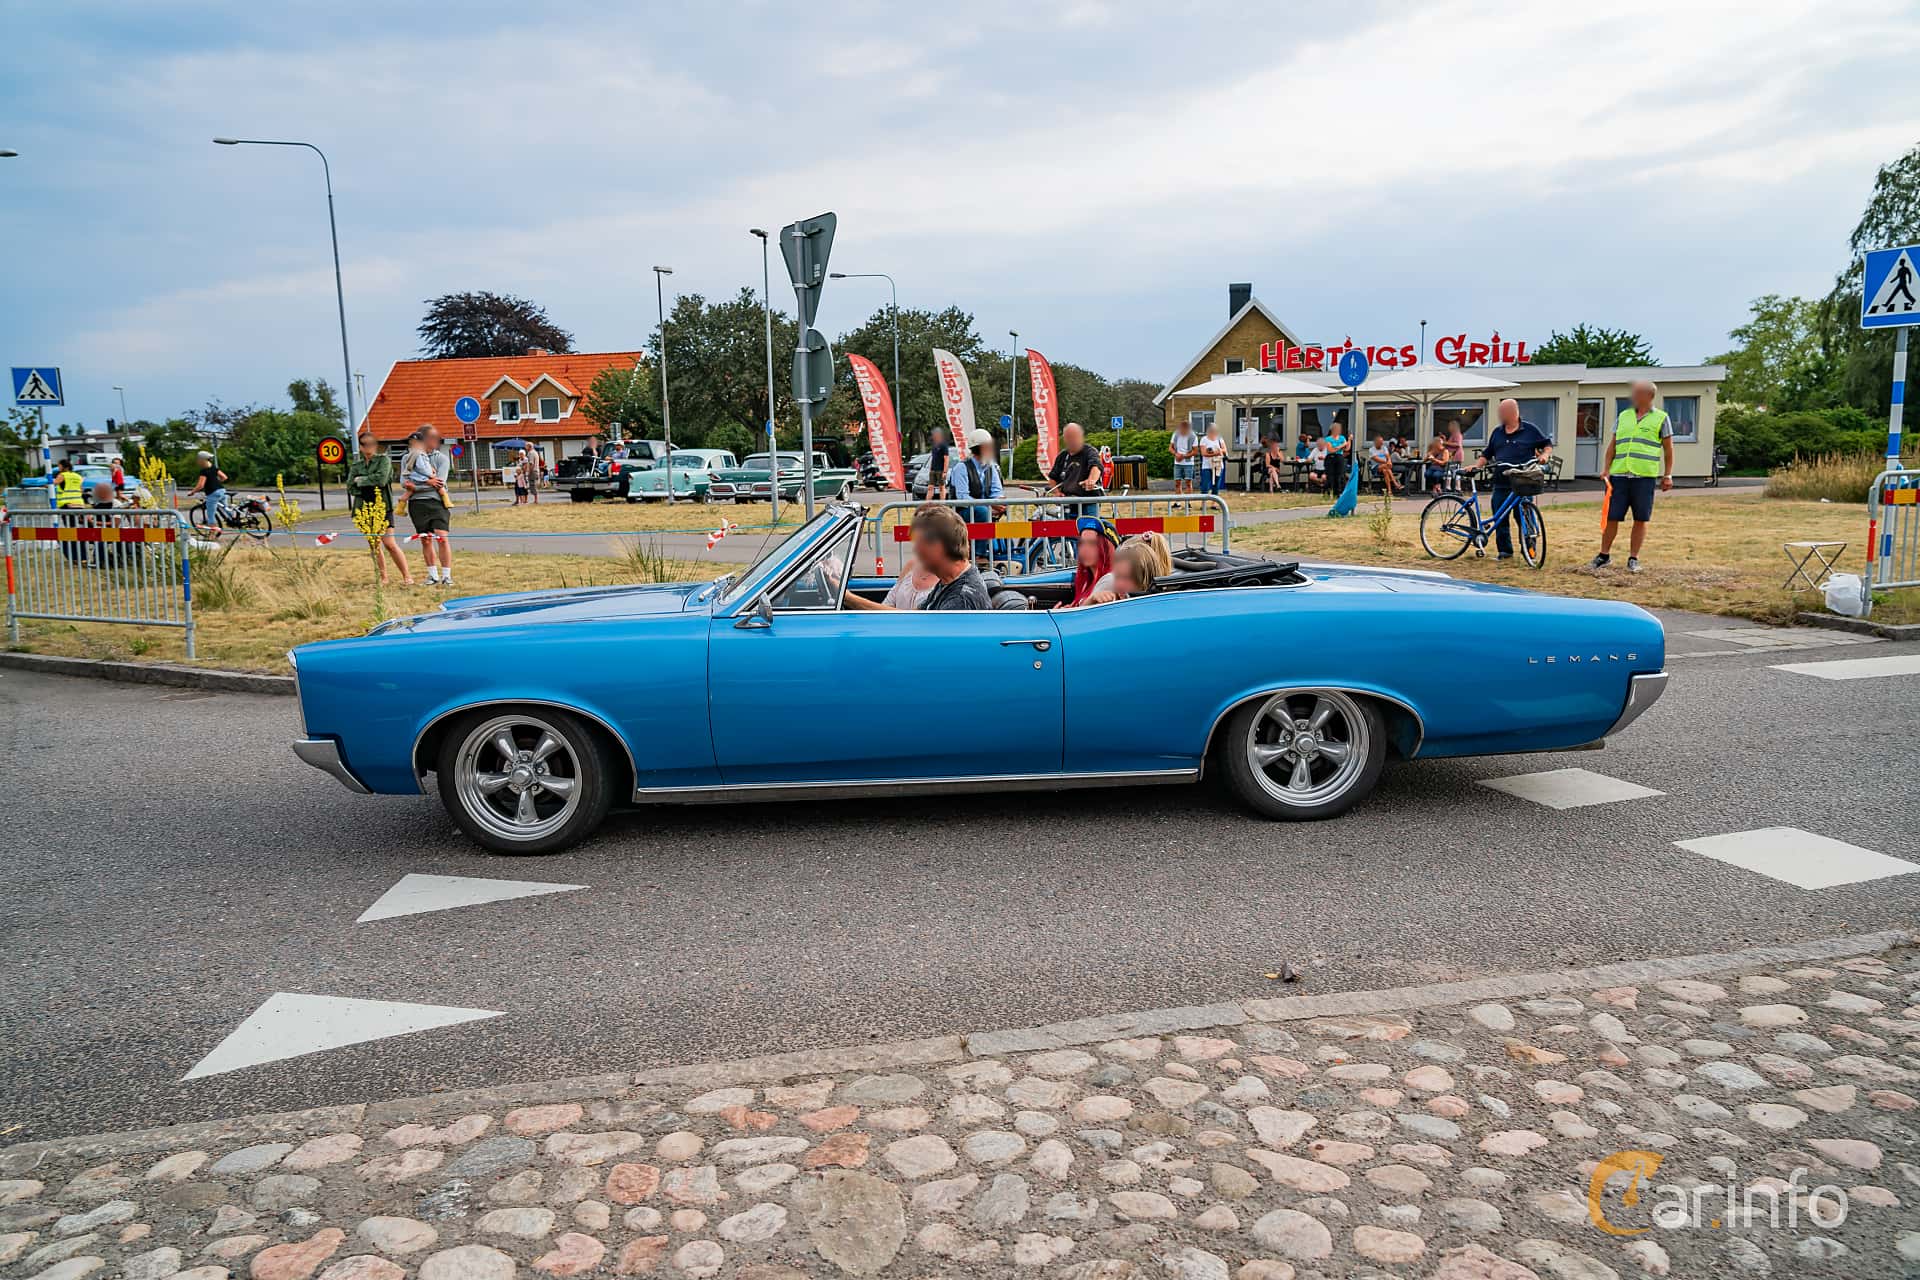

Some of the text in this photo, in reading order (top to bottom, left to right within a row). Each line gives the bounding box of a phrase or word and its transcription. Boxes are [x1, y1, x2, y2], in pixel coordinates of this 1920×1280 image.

[1260, 333, 1532, 372] HERTGS GRILL
[323, 445, 339, 457] 30
[1528, 653, 1638, 664] LE MANS
